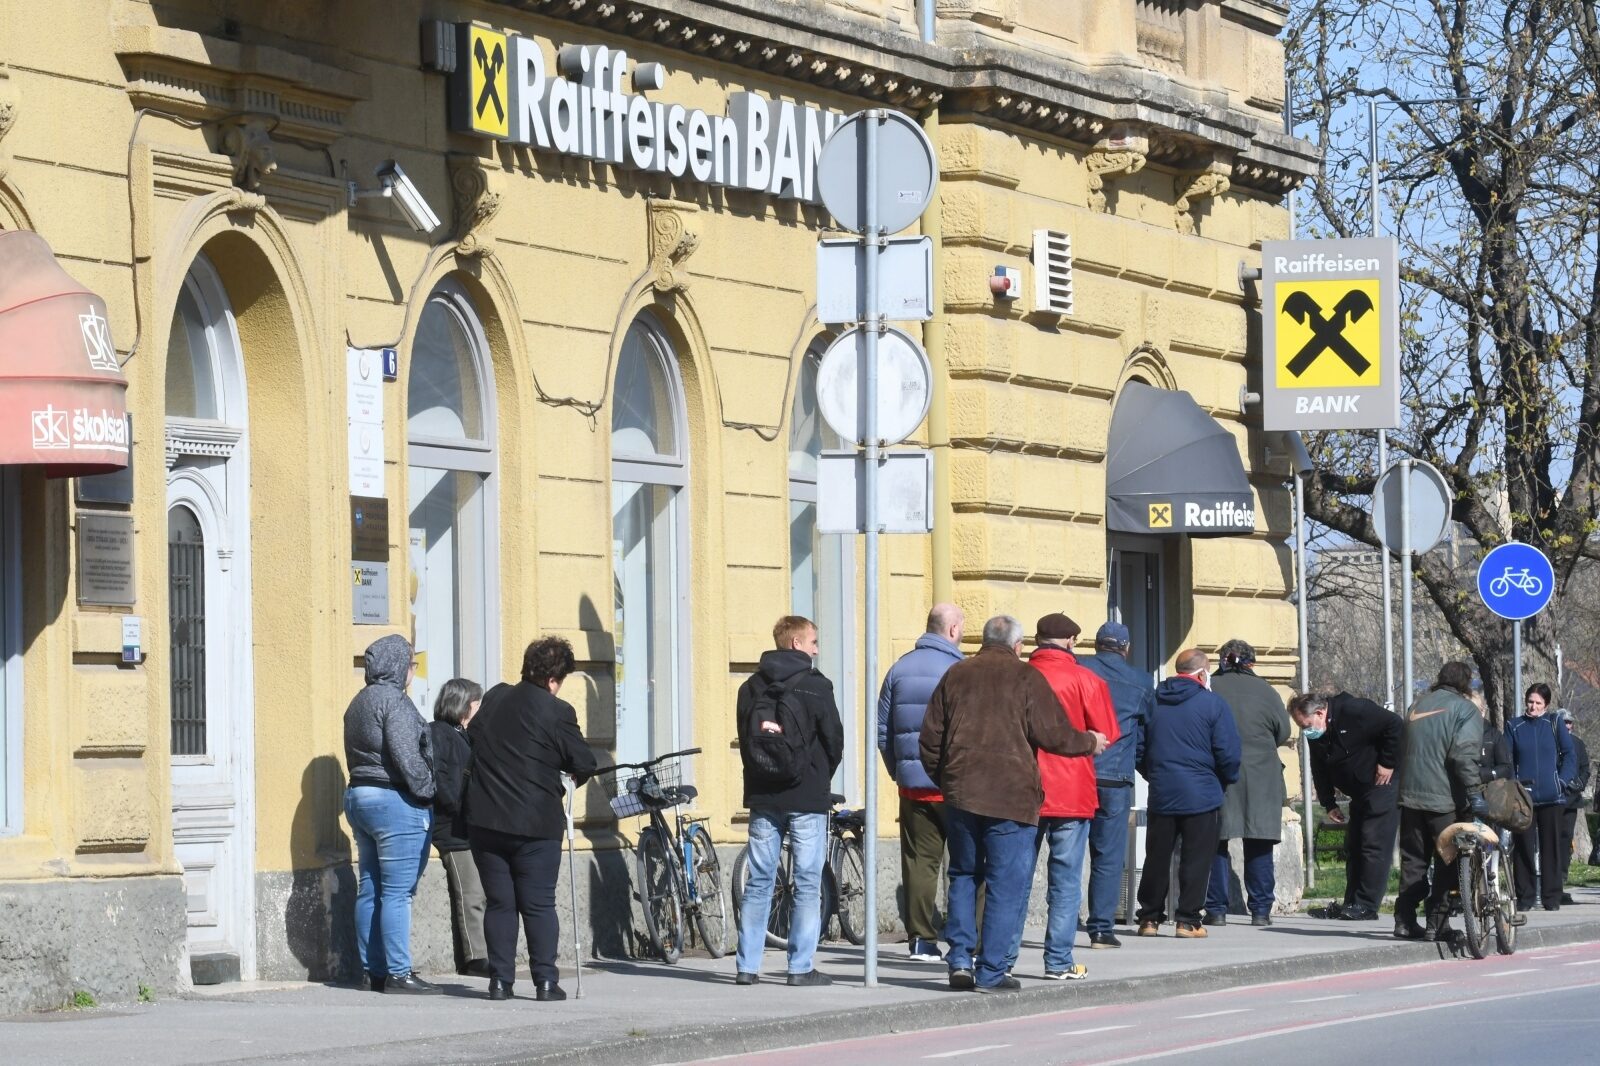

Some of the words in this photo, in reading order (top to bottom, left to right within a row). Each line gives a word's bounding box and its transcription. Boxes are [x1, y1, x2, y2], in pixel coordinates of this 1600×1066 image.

[516, 37, 739, 186] Raiffeisen
[747, 91, 847, 200] BAN
[1274, 253, 1380, 274] Raiffeisen
[389, 352, 396, 374] 6
[1295, 395, 1361, 414] BANK
